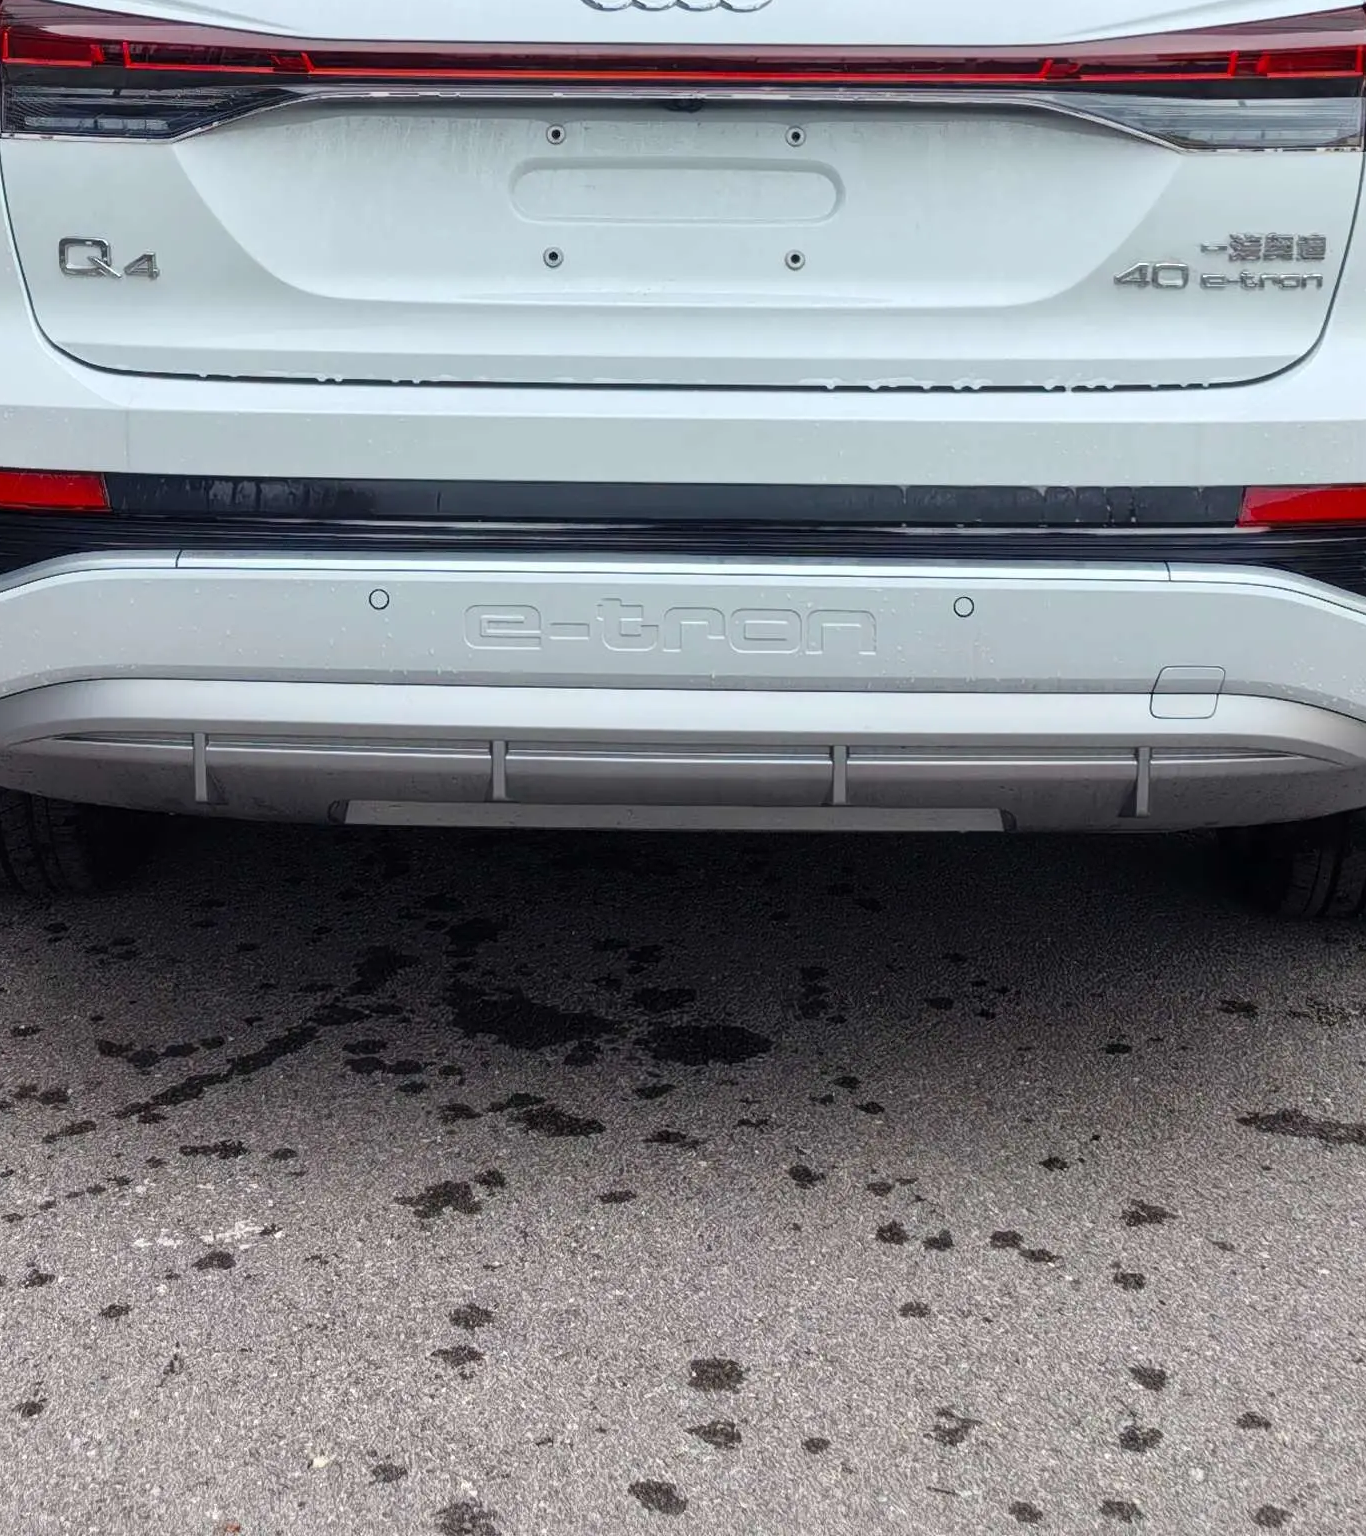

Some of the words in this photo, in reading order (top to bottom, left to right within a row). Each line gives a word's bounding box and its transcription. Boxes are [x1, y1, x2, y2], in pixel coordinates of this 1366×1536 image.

[58, 235, 161, 281] Q4
[1114, 262, 1189, 290] 40
[1200, 270, 1324, 290] e-tron
[463, 597, 877, 655] e-tron
